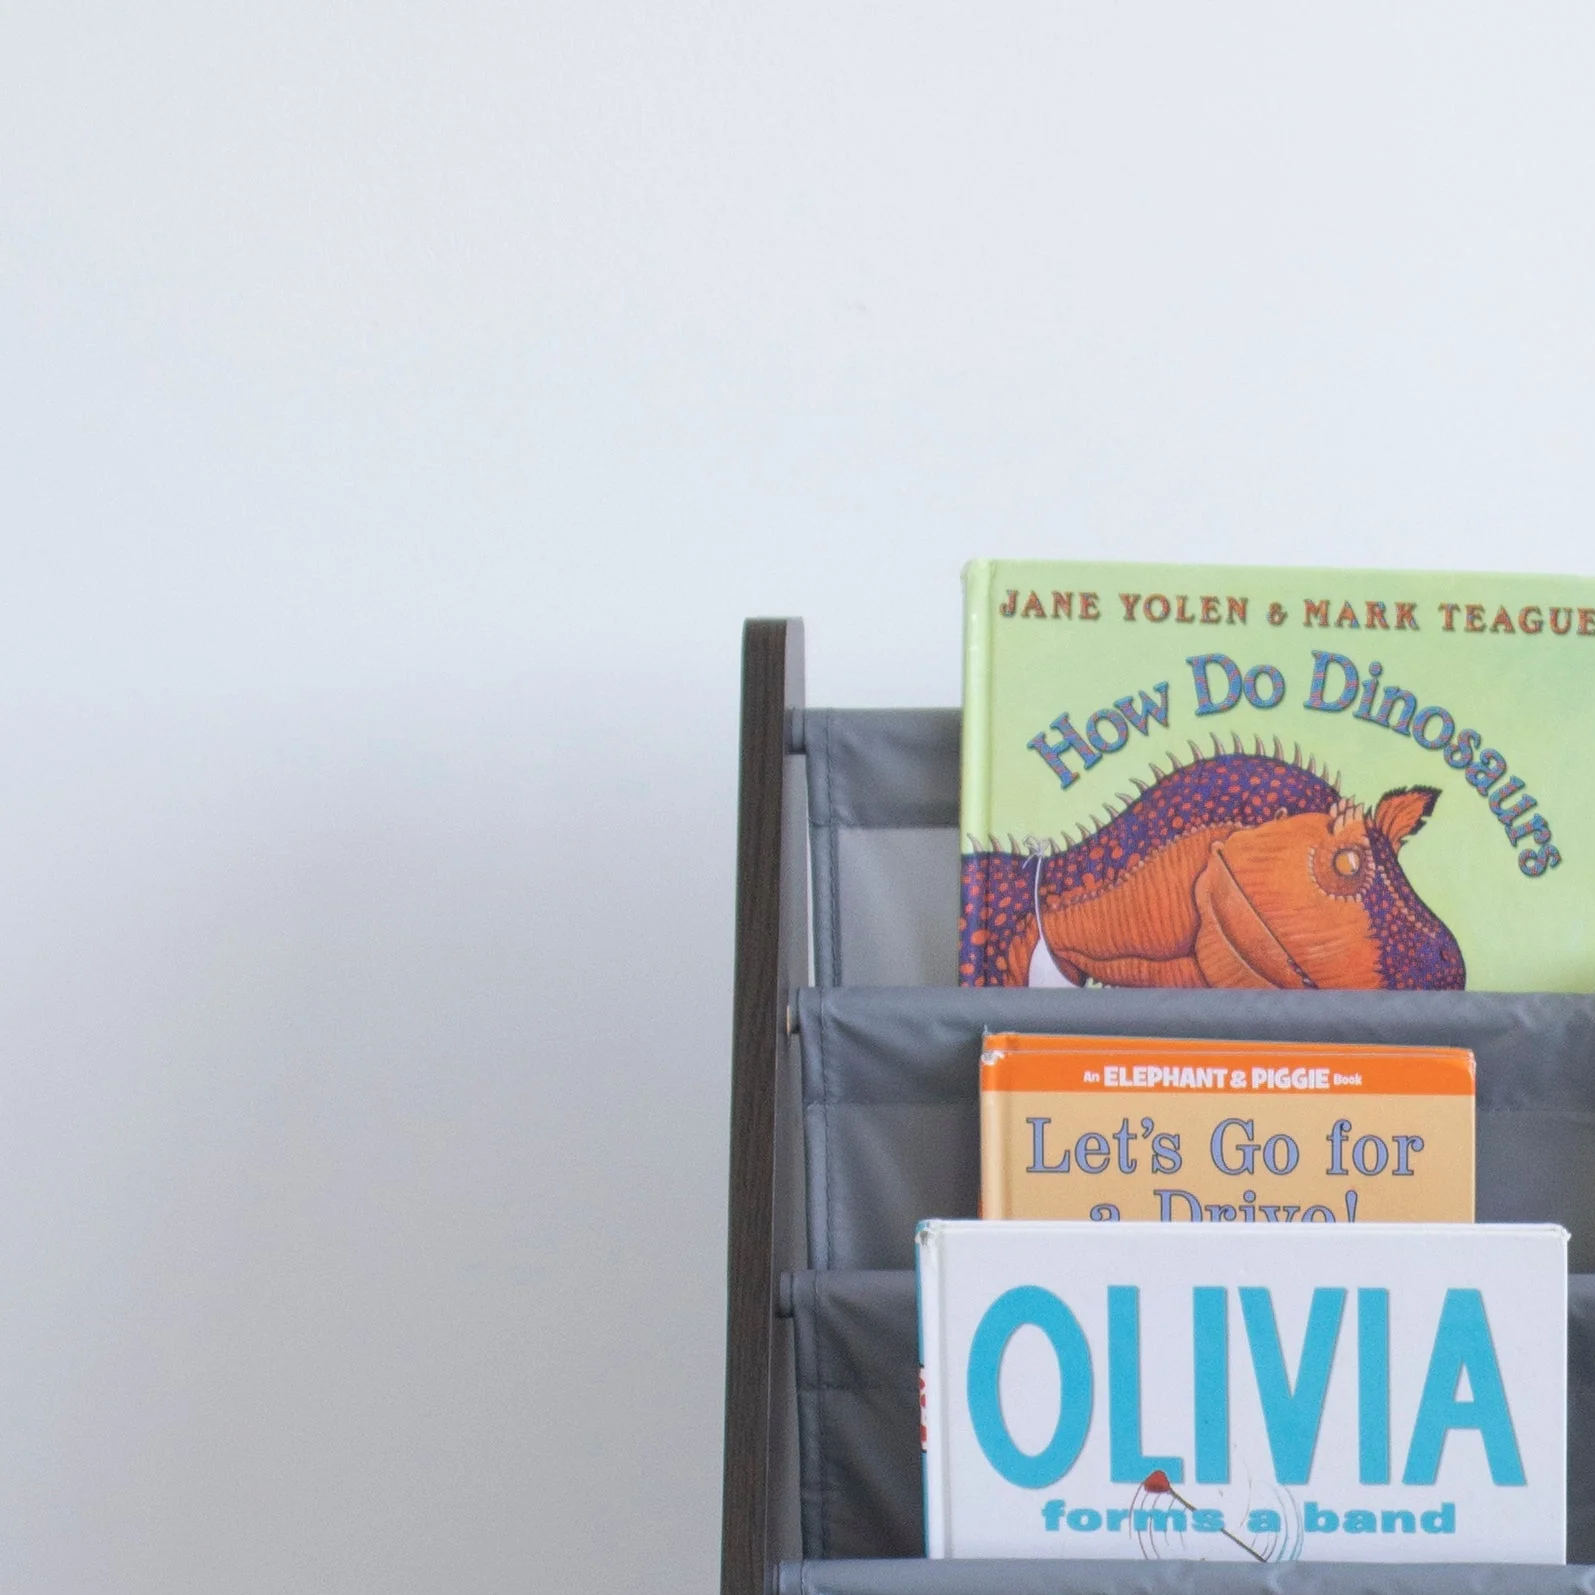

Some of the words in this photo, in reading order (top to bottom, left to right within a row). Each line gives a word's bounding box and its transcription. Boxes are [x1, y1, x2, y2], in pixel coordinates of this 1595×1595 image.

[1000, 589, 1100, 620] JANE
[1120, 593, 1249, 625] YOLEN
[1268, 602, 1289, 626] &
[1303, 598, 1420, 630] MARK
[1026, 681, 1171, 789] How
[1185, 651, 1285, 718] Do
[1302, 649, 1563, 879] Dinosaurs
[1083, 1070, 1100, 1084] An
[1104, 1066, 1229, 1088] ELEPHANT
[1230, 1070, 1247, 1088] &
[1251, 1068, 1330, 1090] PIGGIE
[1333, 1072, 1362, 1087] Book
[1026, 1116, 1183, 1174] Let's
[1210, 1118, 1300, 1176] Go
[1325, 1119, 1425, 1177] for
[966, 1284, 1527, 1489] OLIVIA
[1041, 1498, 1227, 1534] forms
[1247, 1507, 1282, 1535] a
[1303, 1501, 1457, 1535] band
